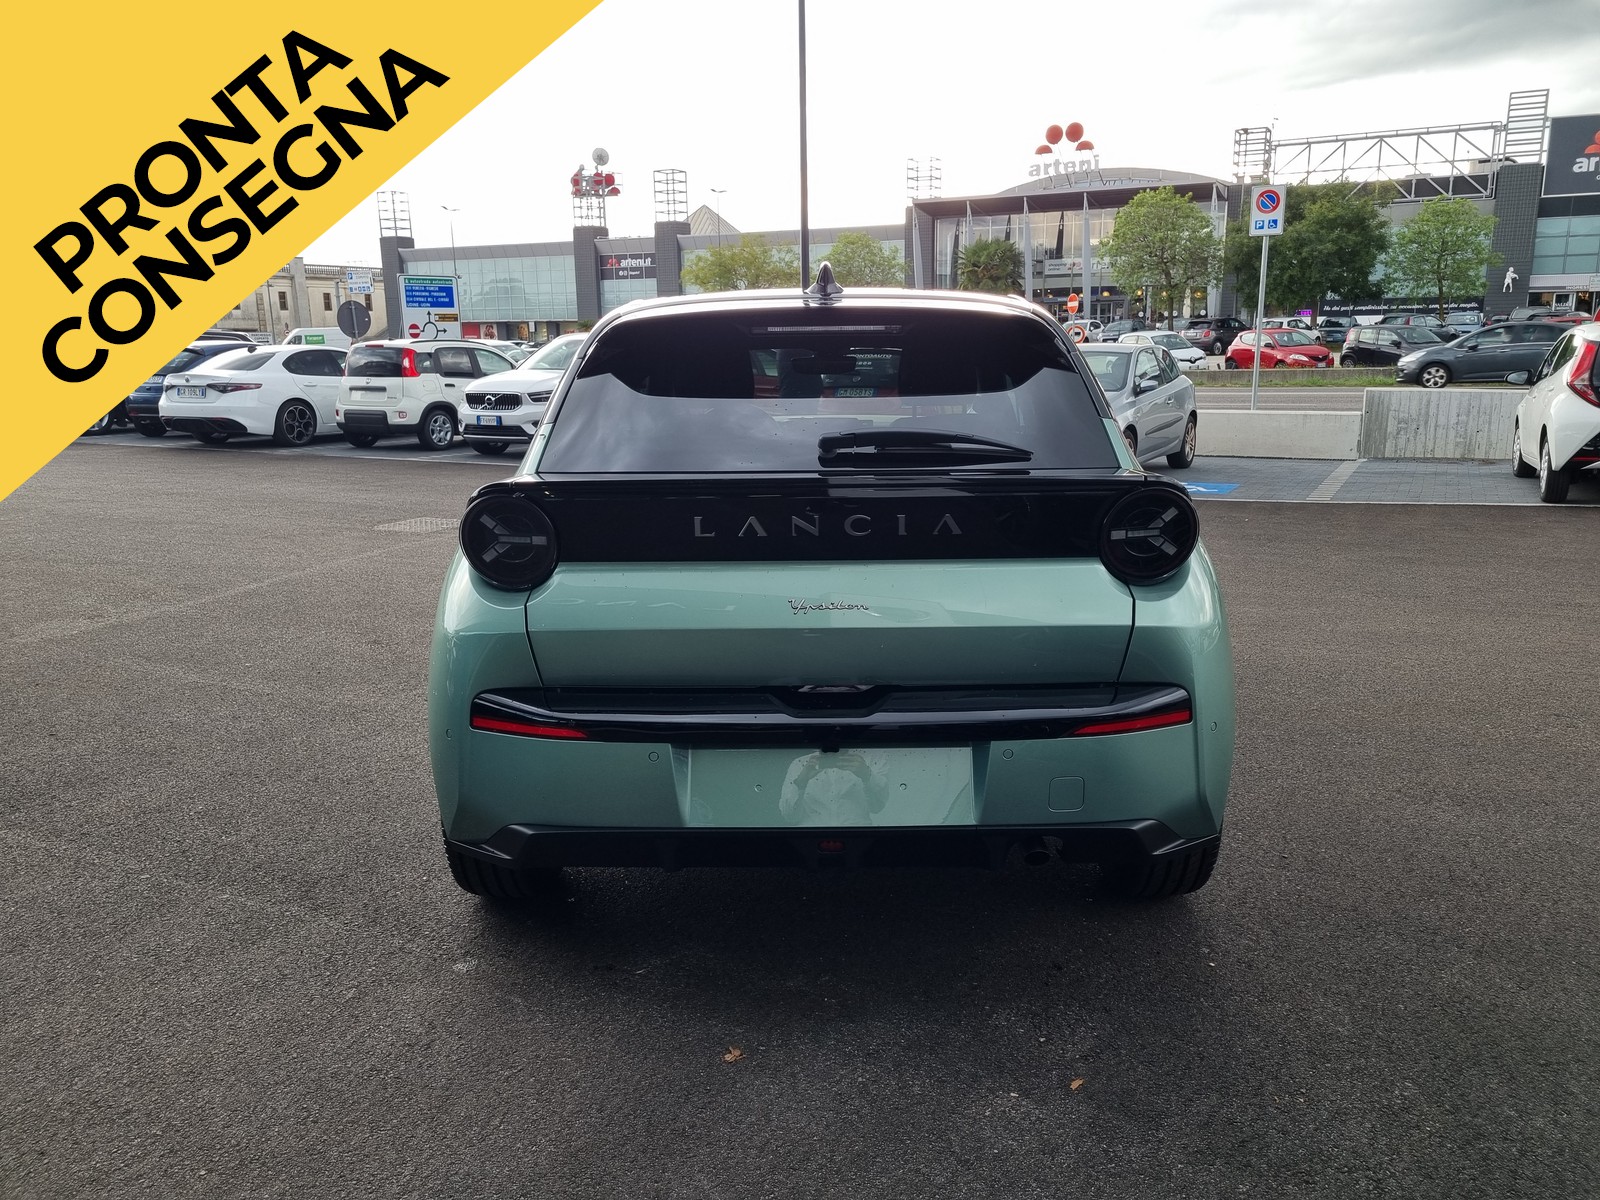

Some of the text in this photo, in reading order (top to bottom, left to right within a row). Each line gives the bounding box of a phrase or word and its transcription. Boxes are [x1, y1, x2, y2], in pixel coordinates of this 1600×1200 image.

[1028, 155, 1100, 177] arteni
[1572, 156, 1600, 173] ar
[693, 513, 963, 537] LANCIA
[787, 598, 869, 615] Ypsilon
